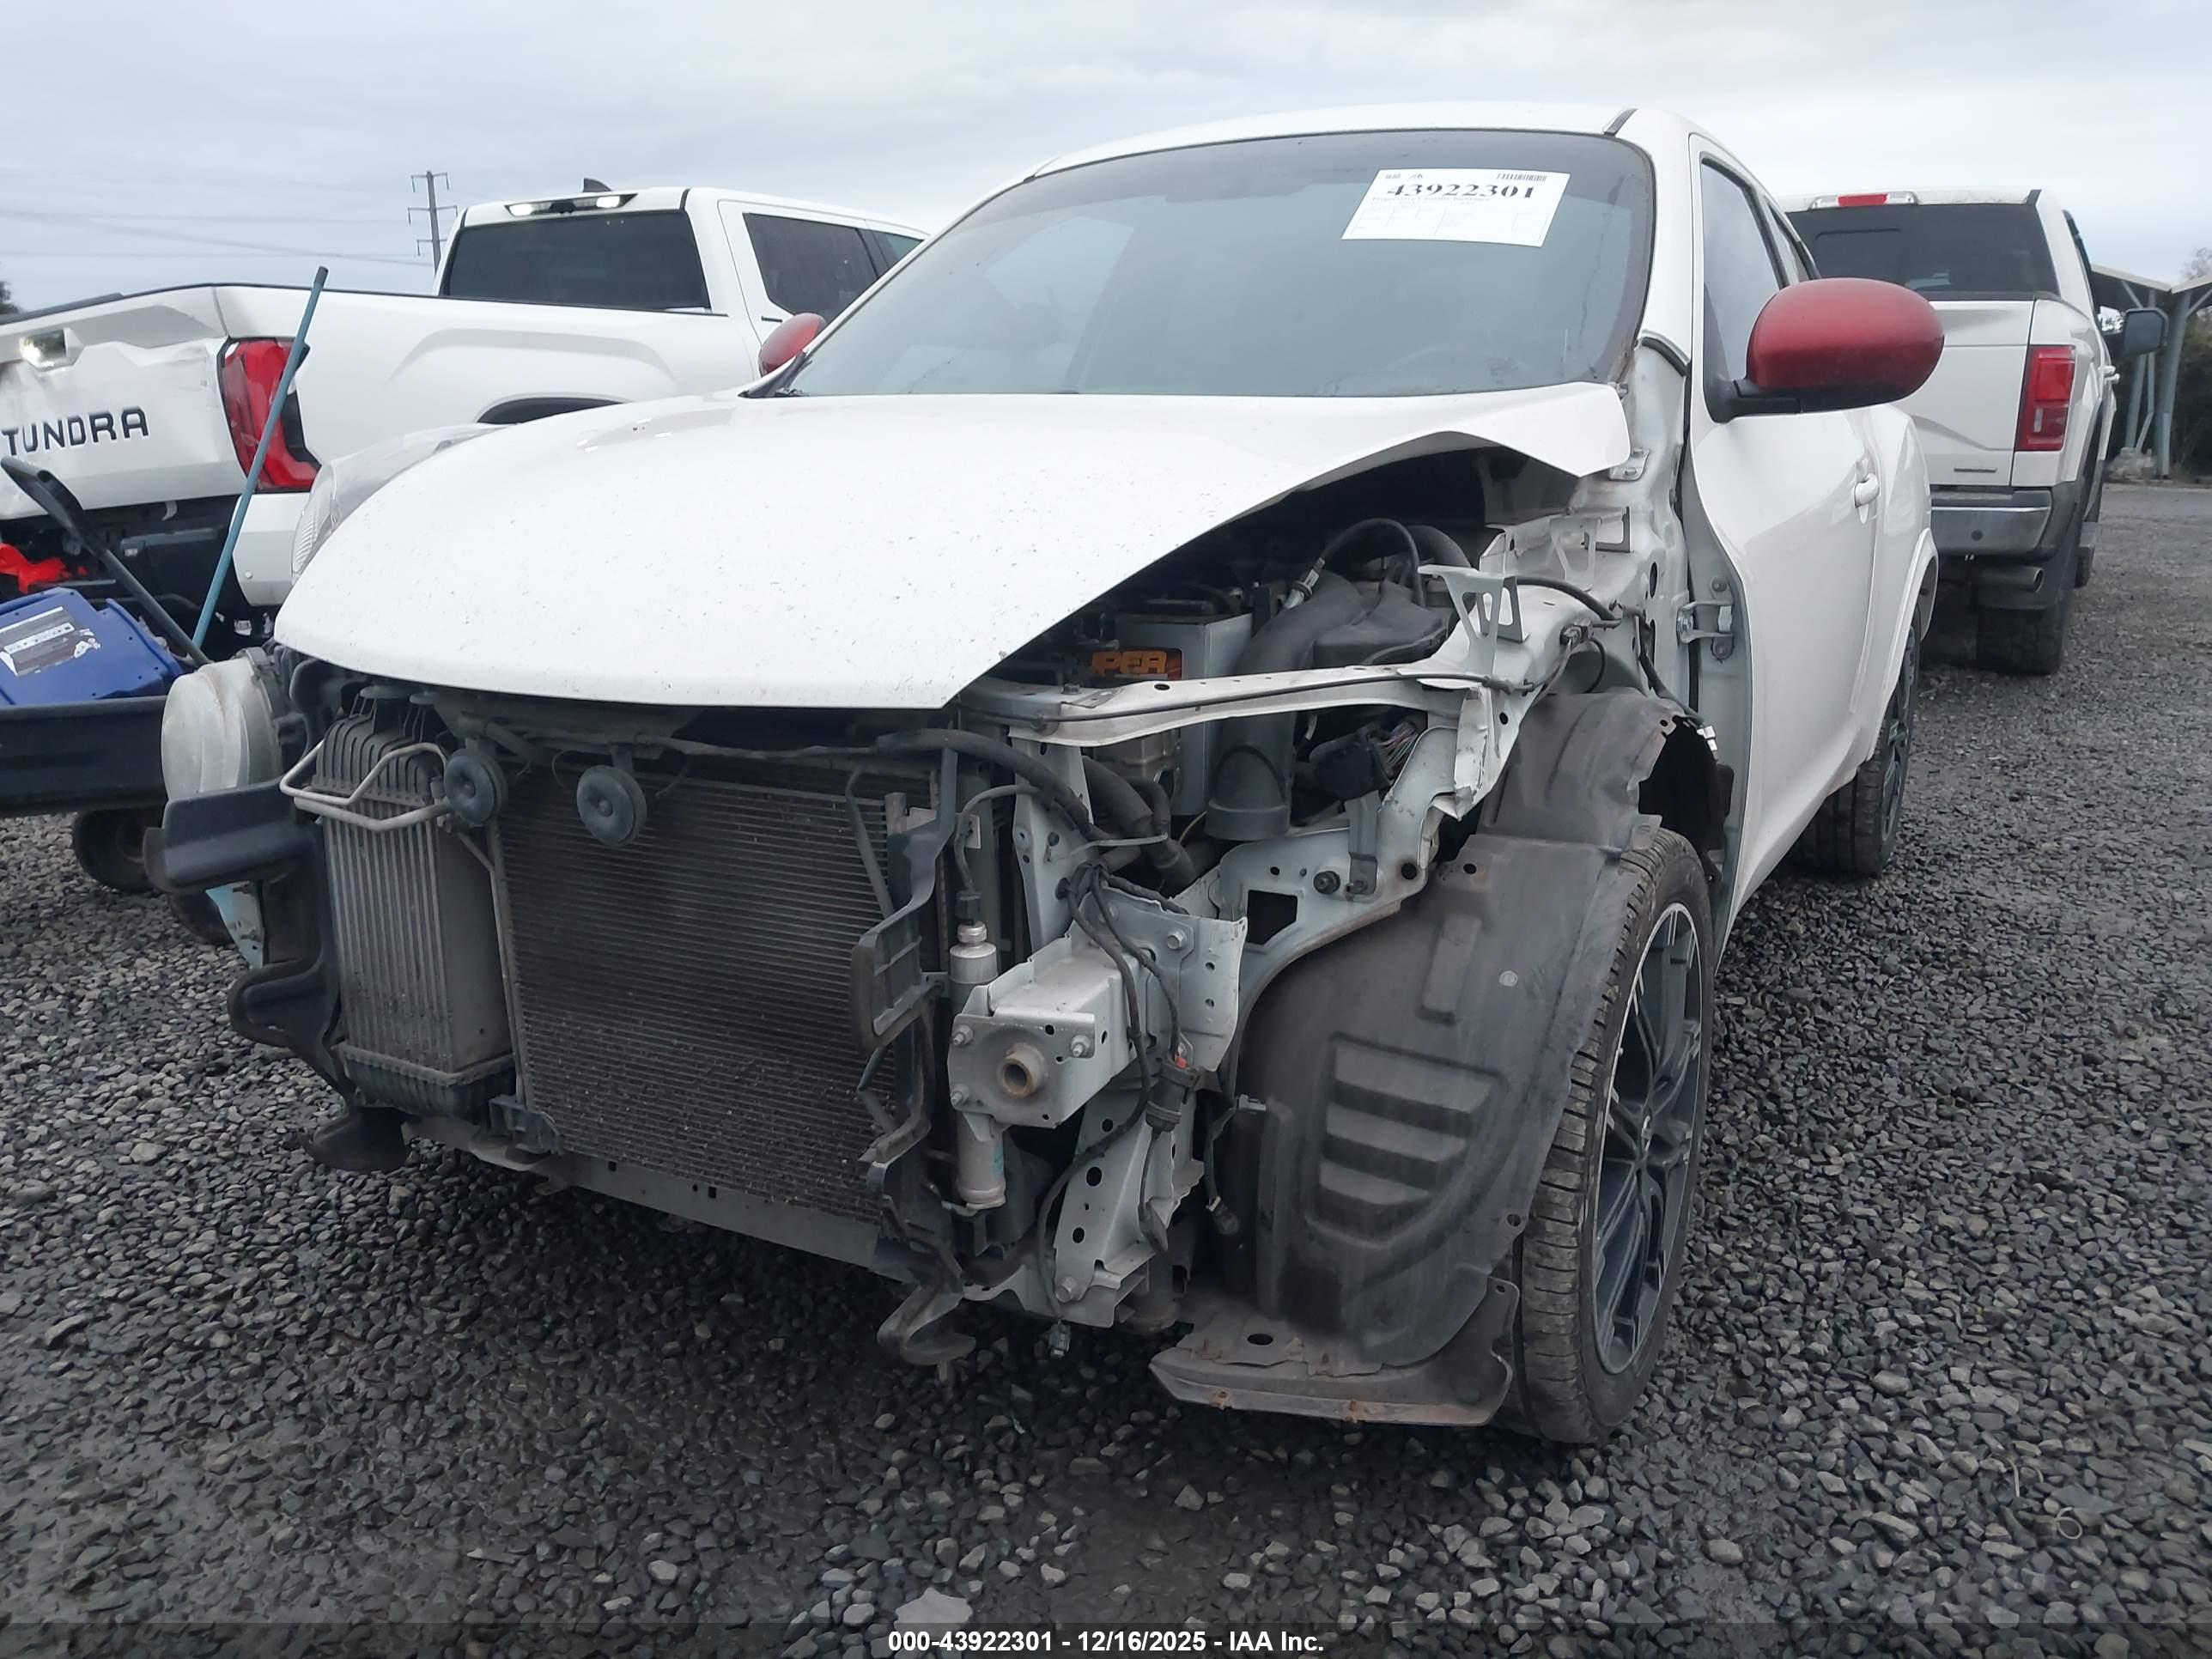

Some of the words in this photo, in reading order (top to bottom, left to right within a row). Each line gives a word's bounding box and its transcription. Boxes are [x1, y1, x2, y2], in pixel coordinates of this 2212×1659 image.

[1387, 184, 1535, 199] 43922301
[2, 406, 149, 456] TUNDRA
[1091, 650, 1168, 674] PER
